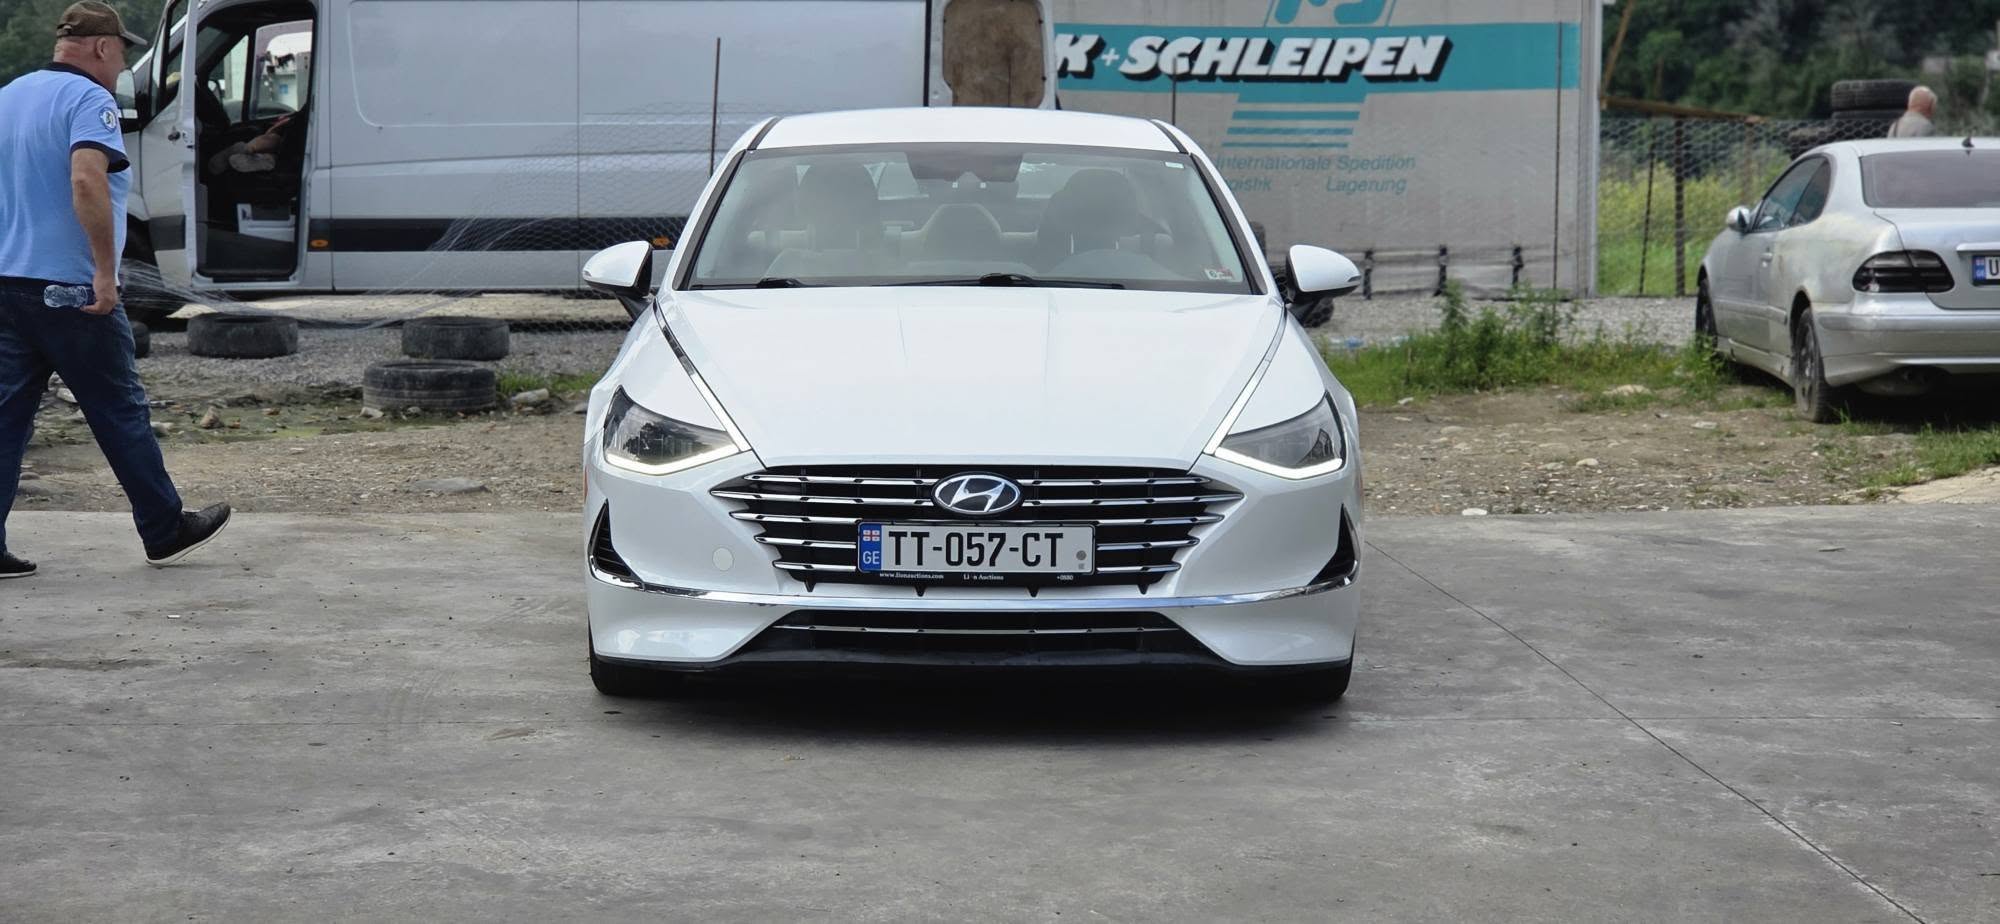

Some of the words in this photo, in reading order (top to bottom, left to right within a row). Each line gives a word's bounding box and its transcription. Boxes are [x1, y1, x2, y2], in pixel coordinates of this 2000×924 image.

[1118, 35, 1453, 83] SCHLEIPEN
[1217, 154, 1331, 172] Internationale
[1338, 154, 1416, 174] Spedition
[1325, 176, 1408, 195] Lagerung
[862, 550, 880, 565] GE
[888, 531, 1064, 568] TT-057-CT
